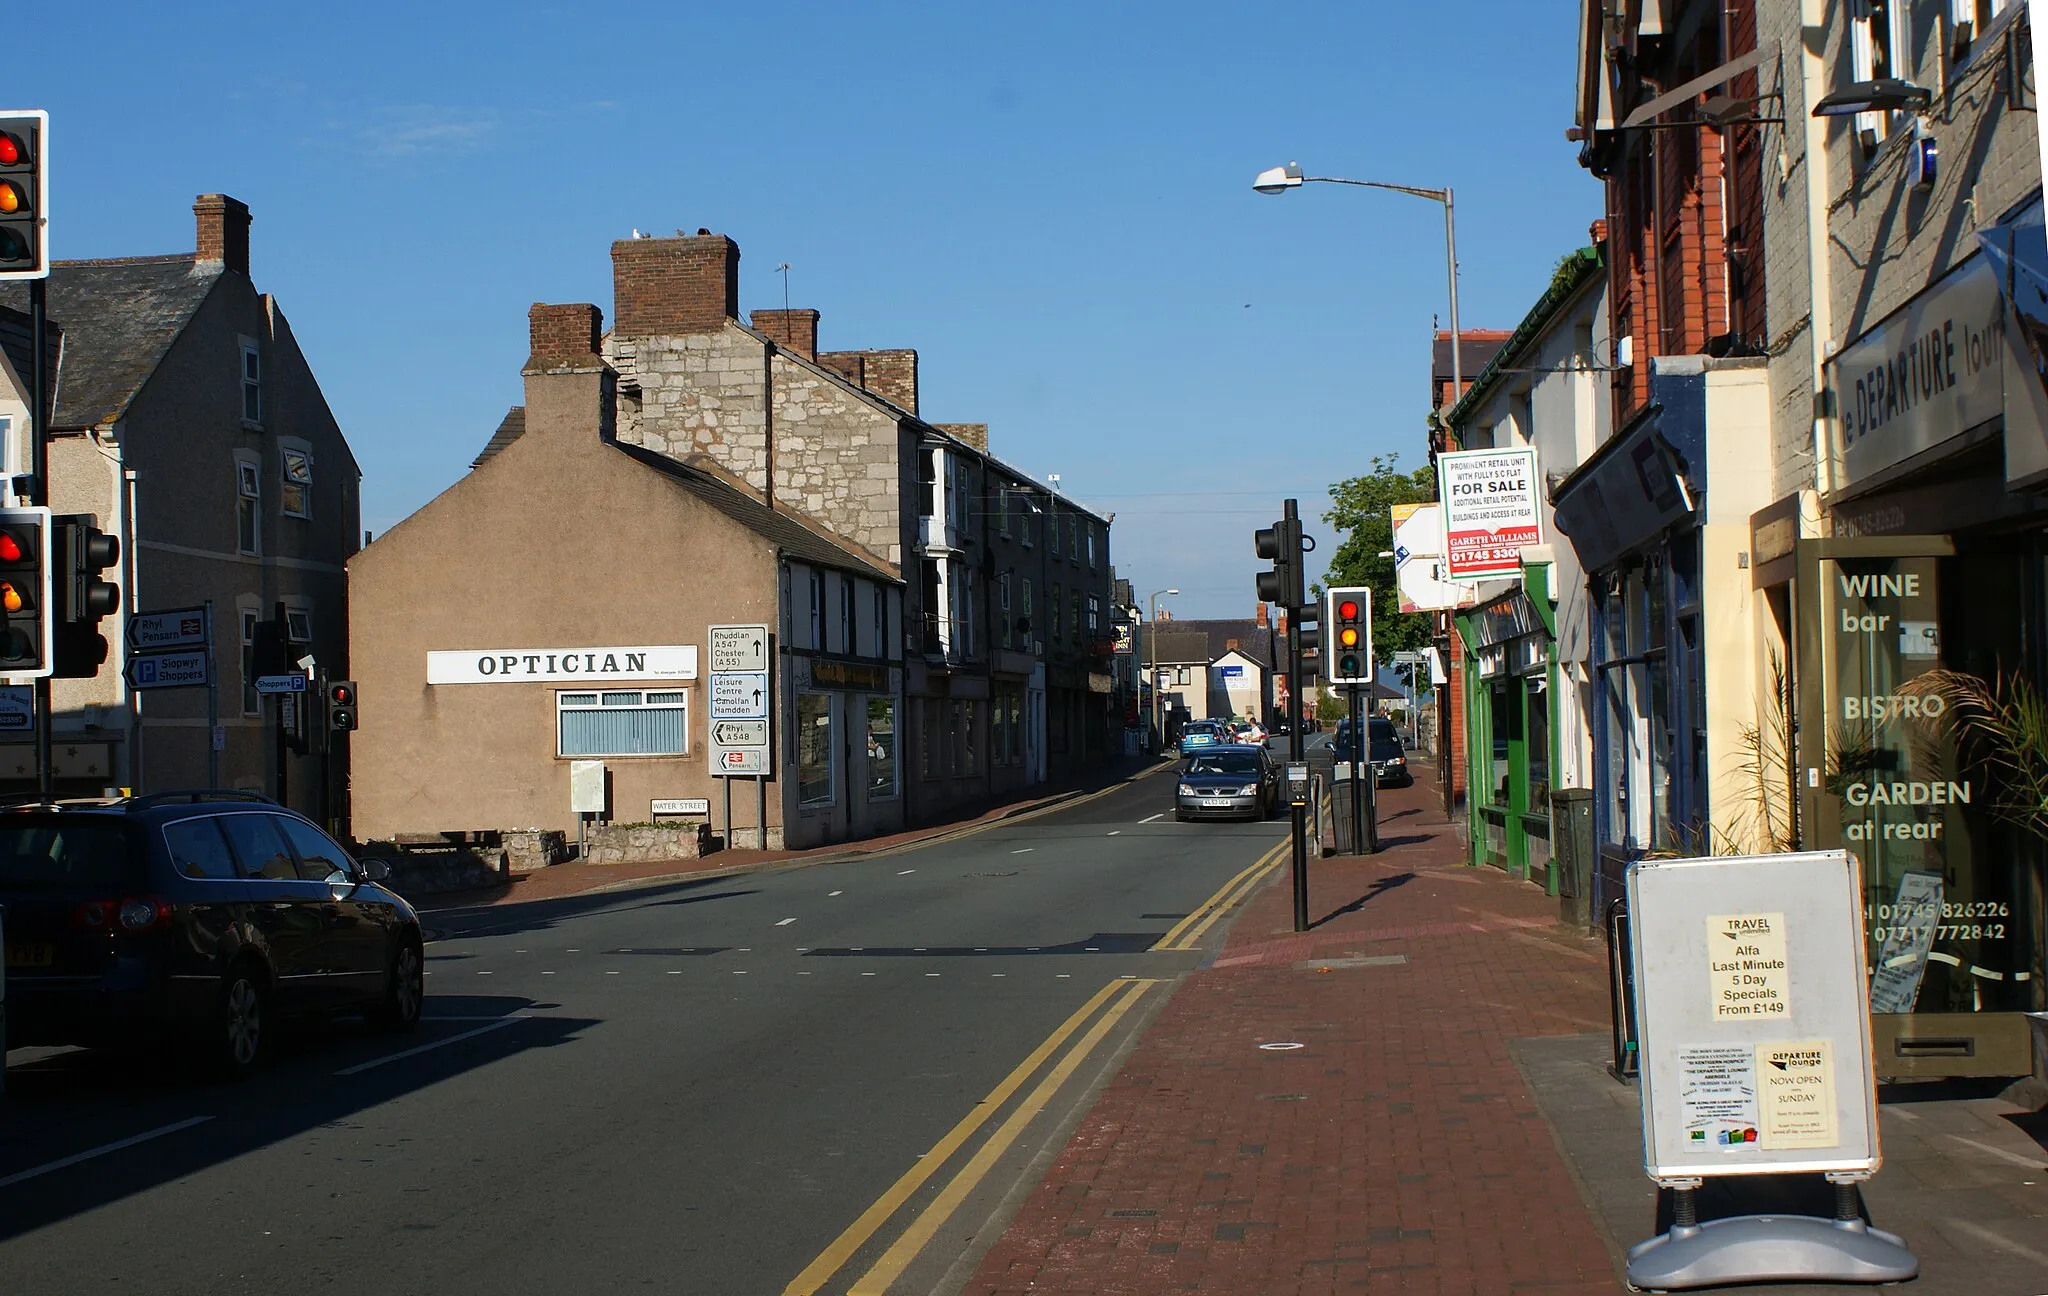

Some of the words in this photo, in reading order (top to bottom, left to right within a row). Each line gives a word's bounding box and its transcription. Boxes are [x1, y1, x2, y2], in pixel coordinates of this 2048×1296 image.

[1856, 319, 1956, 437] DEPARTURE
[1451, 461, 1486, 470] PROMINENT
[1488, 459, 1510, 468] RETAIL
[1511, 458, 1526, 466] UNIT
[1456, 472, 1472, 480] WITH
[1474, 471, 1493, 480] FULLY
[1506, 469, 1522, 477] FLAT
[1452, 483, 1483, 496] FOR
[1488, 480, 1527, 492] SALE
[1454, 498, 1482, 507] ADDITIONAL
[1484, 496, 1500, 505] RETAIL
[1501, 494, 1528, 503] POTENTIAL
[1452, 512, 1479, 522] BUILDINGS
[1491, 510, 1510, 518] ACCESS
[1518, 508, 1531, 516] REAR
[1450, 536, 1488, 546] GARETH
[1490, 532, 1537, 543] WILLIAMS
[1452, 550, 1490, 562] 01745
[1841, 574, 1920, 598] WINE
[142, 620, 162, 630] Rhyl
[1842, 608, 1890, 633] bar
[143, 630, 179, 642] Pensarn
[714, 631, 750, 640] Rhuddlan
[714, 649, 745, 658] Chester
[478, 652, 647, 676] OPTICIAN
[160, 670, 203, 682] Shoppers
[258, 679, 290, 688] Shoppers
[714, 678, 743, 687] Leisure
[716, 687, 743, 696] Centre
[714, 706, 750, 715] Hamdden
[1844, 695, 1946, 720] BISTRO
[726, 724, 743, 733] Rhyl
[1846, 781, 1971, 806] GARDEN
[653, 802, 677, 811] WATER
[680, 801, 706, 810] STREET
[1583, 808, 1588, 816] 2
[1846, 820, 1877, 841] at
[1883, 820, 1942, 841] rear
[1879, 904, 1936, 920] 01745
[1942, 902, 2010, 919] 826226
[1728, 918, 1770, 930] TRAVEL
[1739, 927, 1770, 935] unlimited
[1938, 924, 2006, 940] 772842
[1736, 946, 1760, 957] Alfa
[1713, 961, 1740, 972] Last
[1744, 960, 1784, 970] Minute
[1732, 976, 1740, 985] 5
[1744, 974, 1767, 987] Day
[1724, 989, 1777, 1001] Specials
[1719, 1004, 1750, 1015] From
[1754, 1003, 1784, 1014] £149
[1773, 1052, 1821, 1060] DEPARTURE
[1788, 1058, 1821, 1066] lounge
[1796, 1076, 1822, 1084] OPEN
[1778, 1094, 1816, 1103] SUNDAY
